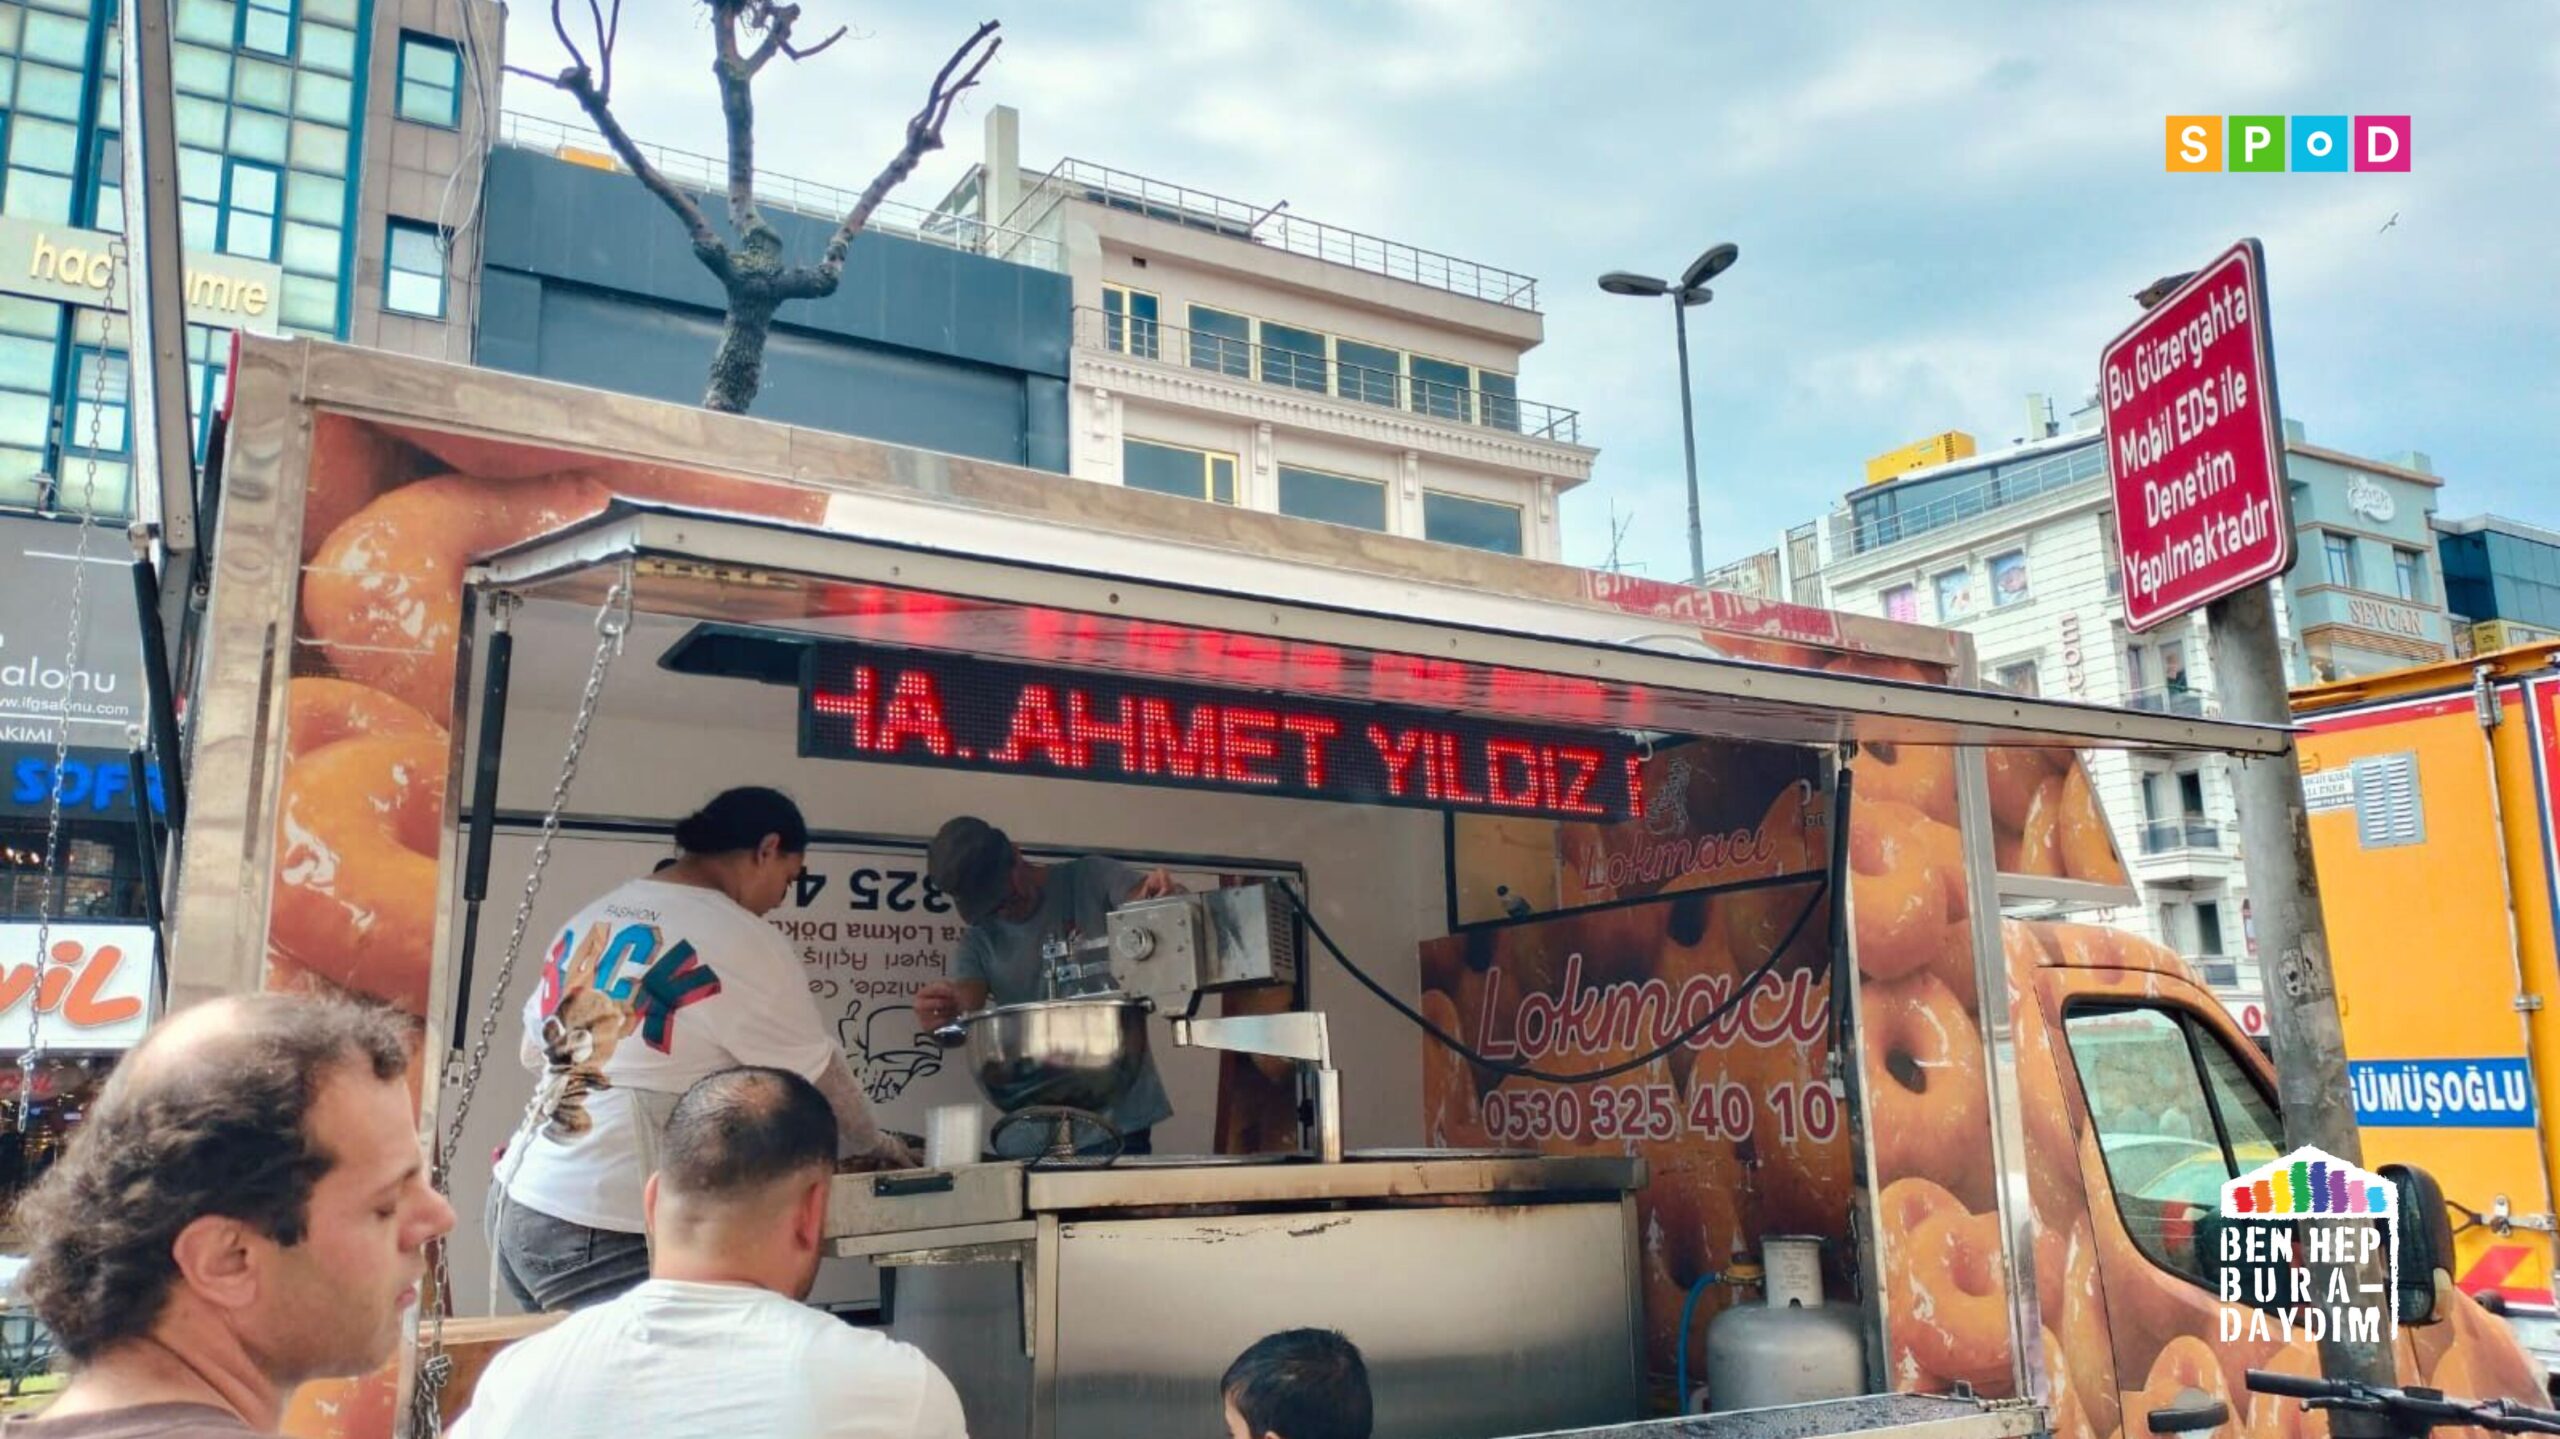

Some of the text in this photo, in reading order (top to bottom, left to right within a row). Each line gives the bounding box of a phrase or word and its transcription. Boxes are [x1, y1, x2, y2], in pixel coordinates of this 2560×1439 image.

[2107, 284, 2249, 411] Bu Güzergahta
[2119, 364, 2249, 480] Mobil EDS ile
[2144, 449, 2236, 529] Denetim
[2125, 496, 2271, 604] Yapılmaktadır
[1365, 721, 1605, 815] YILDIZ
[846, 922, 934, 945] Lokma
[1477, 952, 1830, 1061] Lokmacı
[1483, 1079, 1837, 1143] 0530 325 40 10
